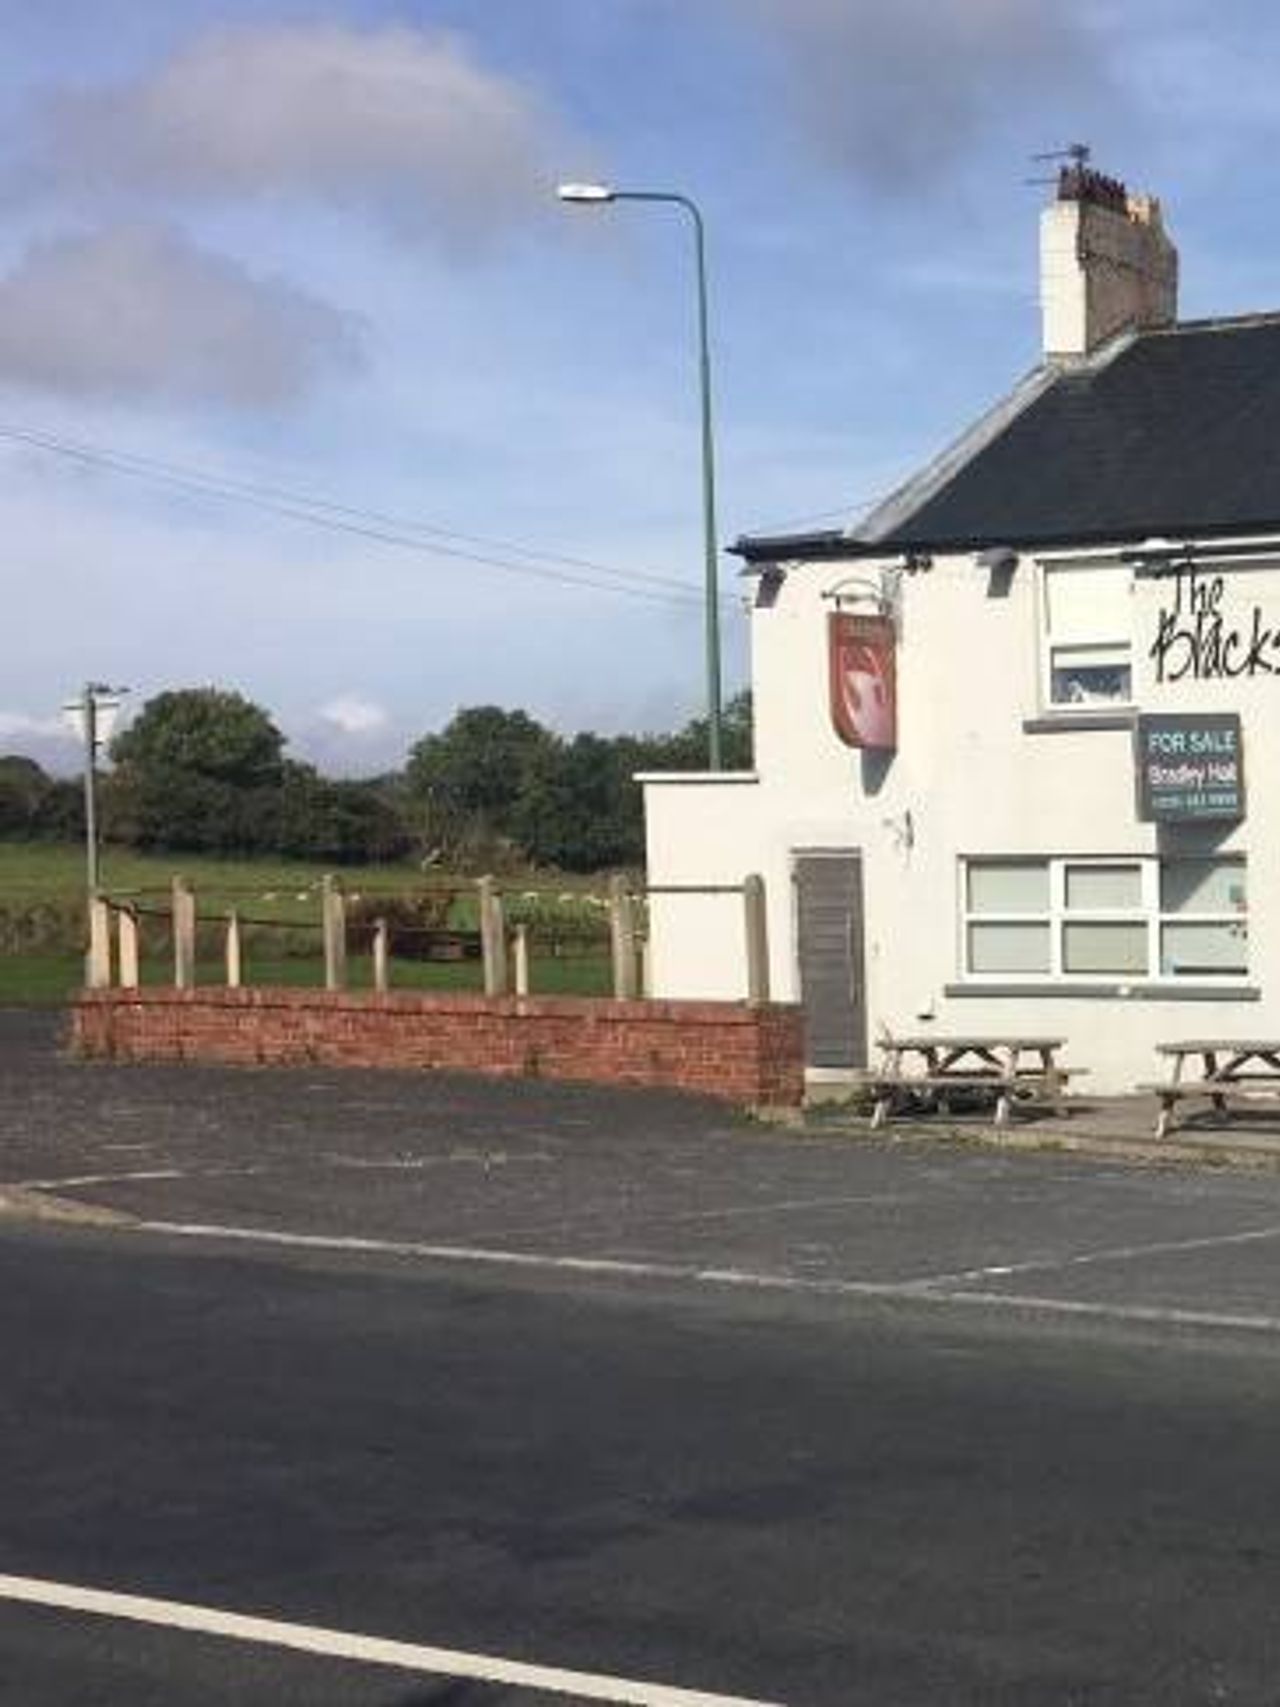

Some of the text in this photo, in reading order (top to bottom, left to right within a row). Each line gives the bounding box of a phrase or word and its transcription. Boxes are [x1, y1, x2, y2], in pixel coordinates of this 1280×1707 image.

[1170, 561, 1224, 618] The
[1149, 730, 1236, 753] FOR SALE
